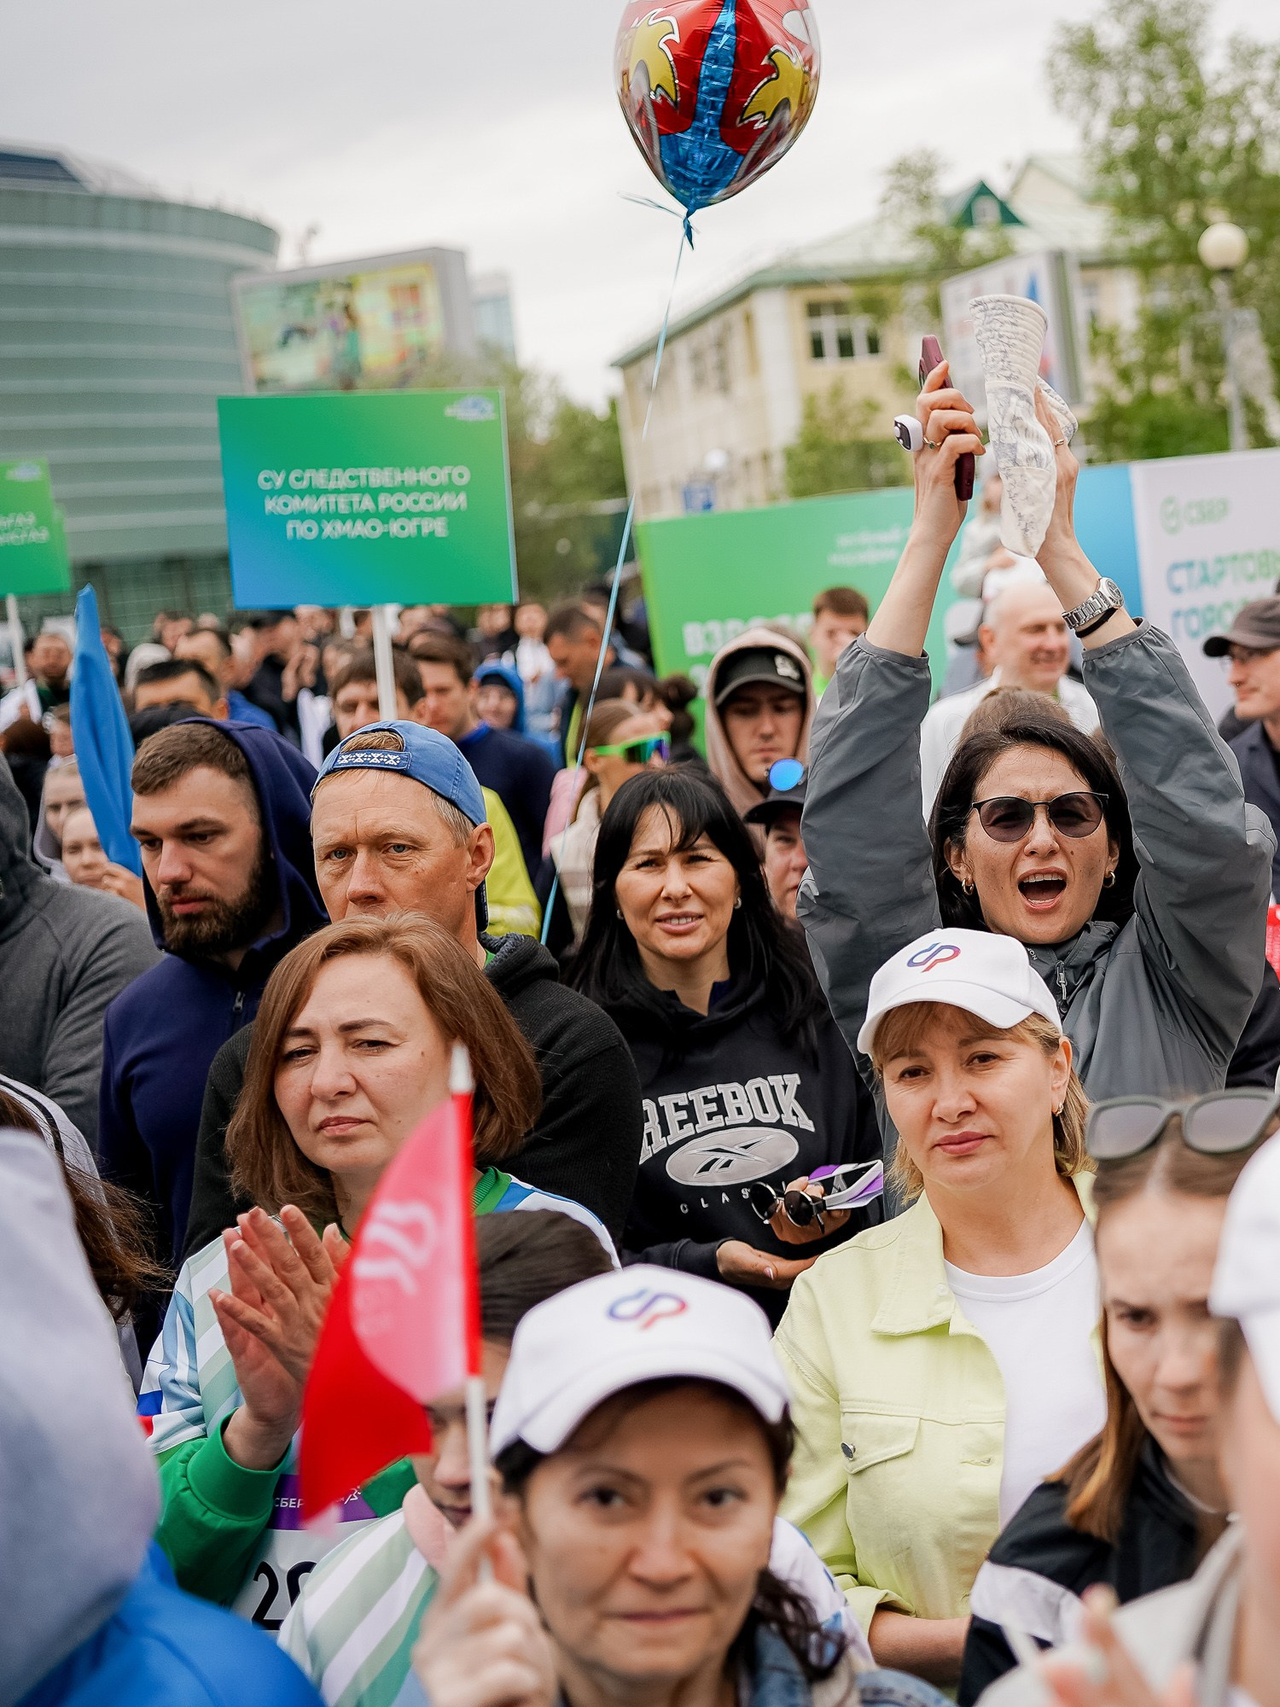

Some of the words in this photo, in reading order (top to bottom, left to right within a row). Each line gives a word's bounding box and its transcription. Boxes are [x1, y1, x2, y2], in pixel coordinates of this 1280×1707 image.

[257, 468, 286, 490] СУ
[288, 465, 471, 491] СЛЕДСТВЕННОГО
[264, 493, 376, 515] КОМИТЕТА
[378, 491, 467, 513] РОССИИ
[286, 519, 319, 540] ПО
[321, 517, 449, 539] ХМАО-ЮГРЕ
[639, 1073, 816, 1165] REEBOK
